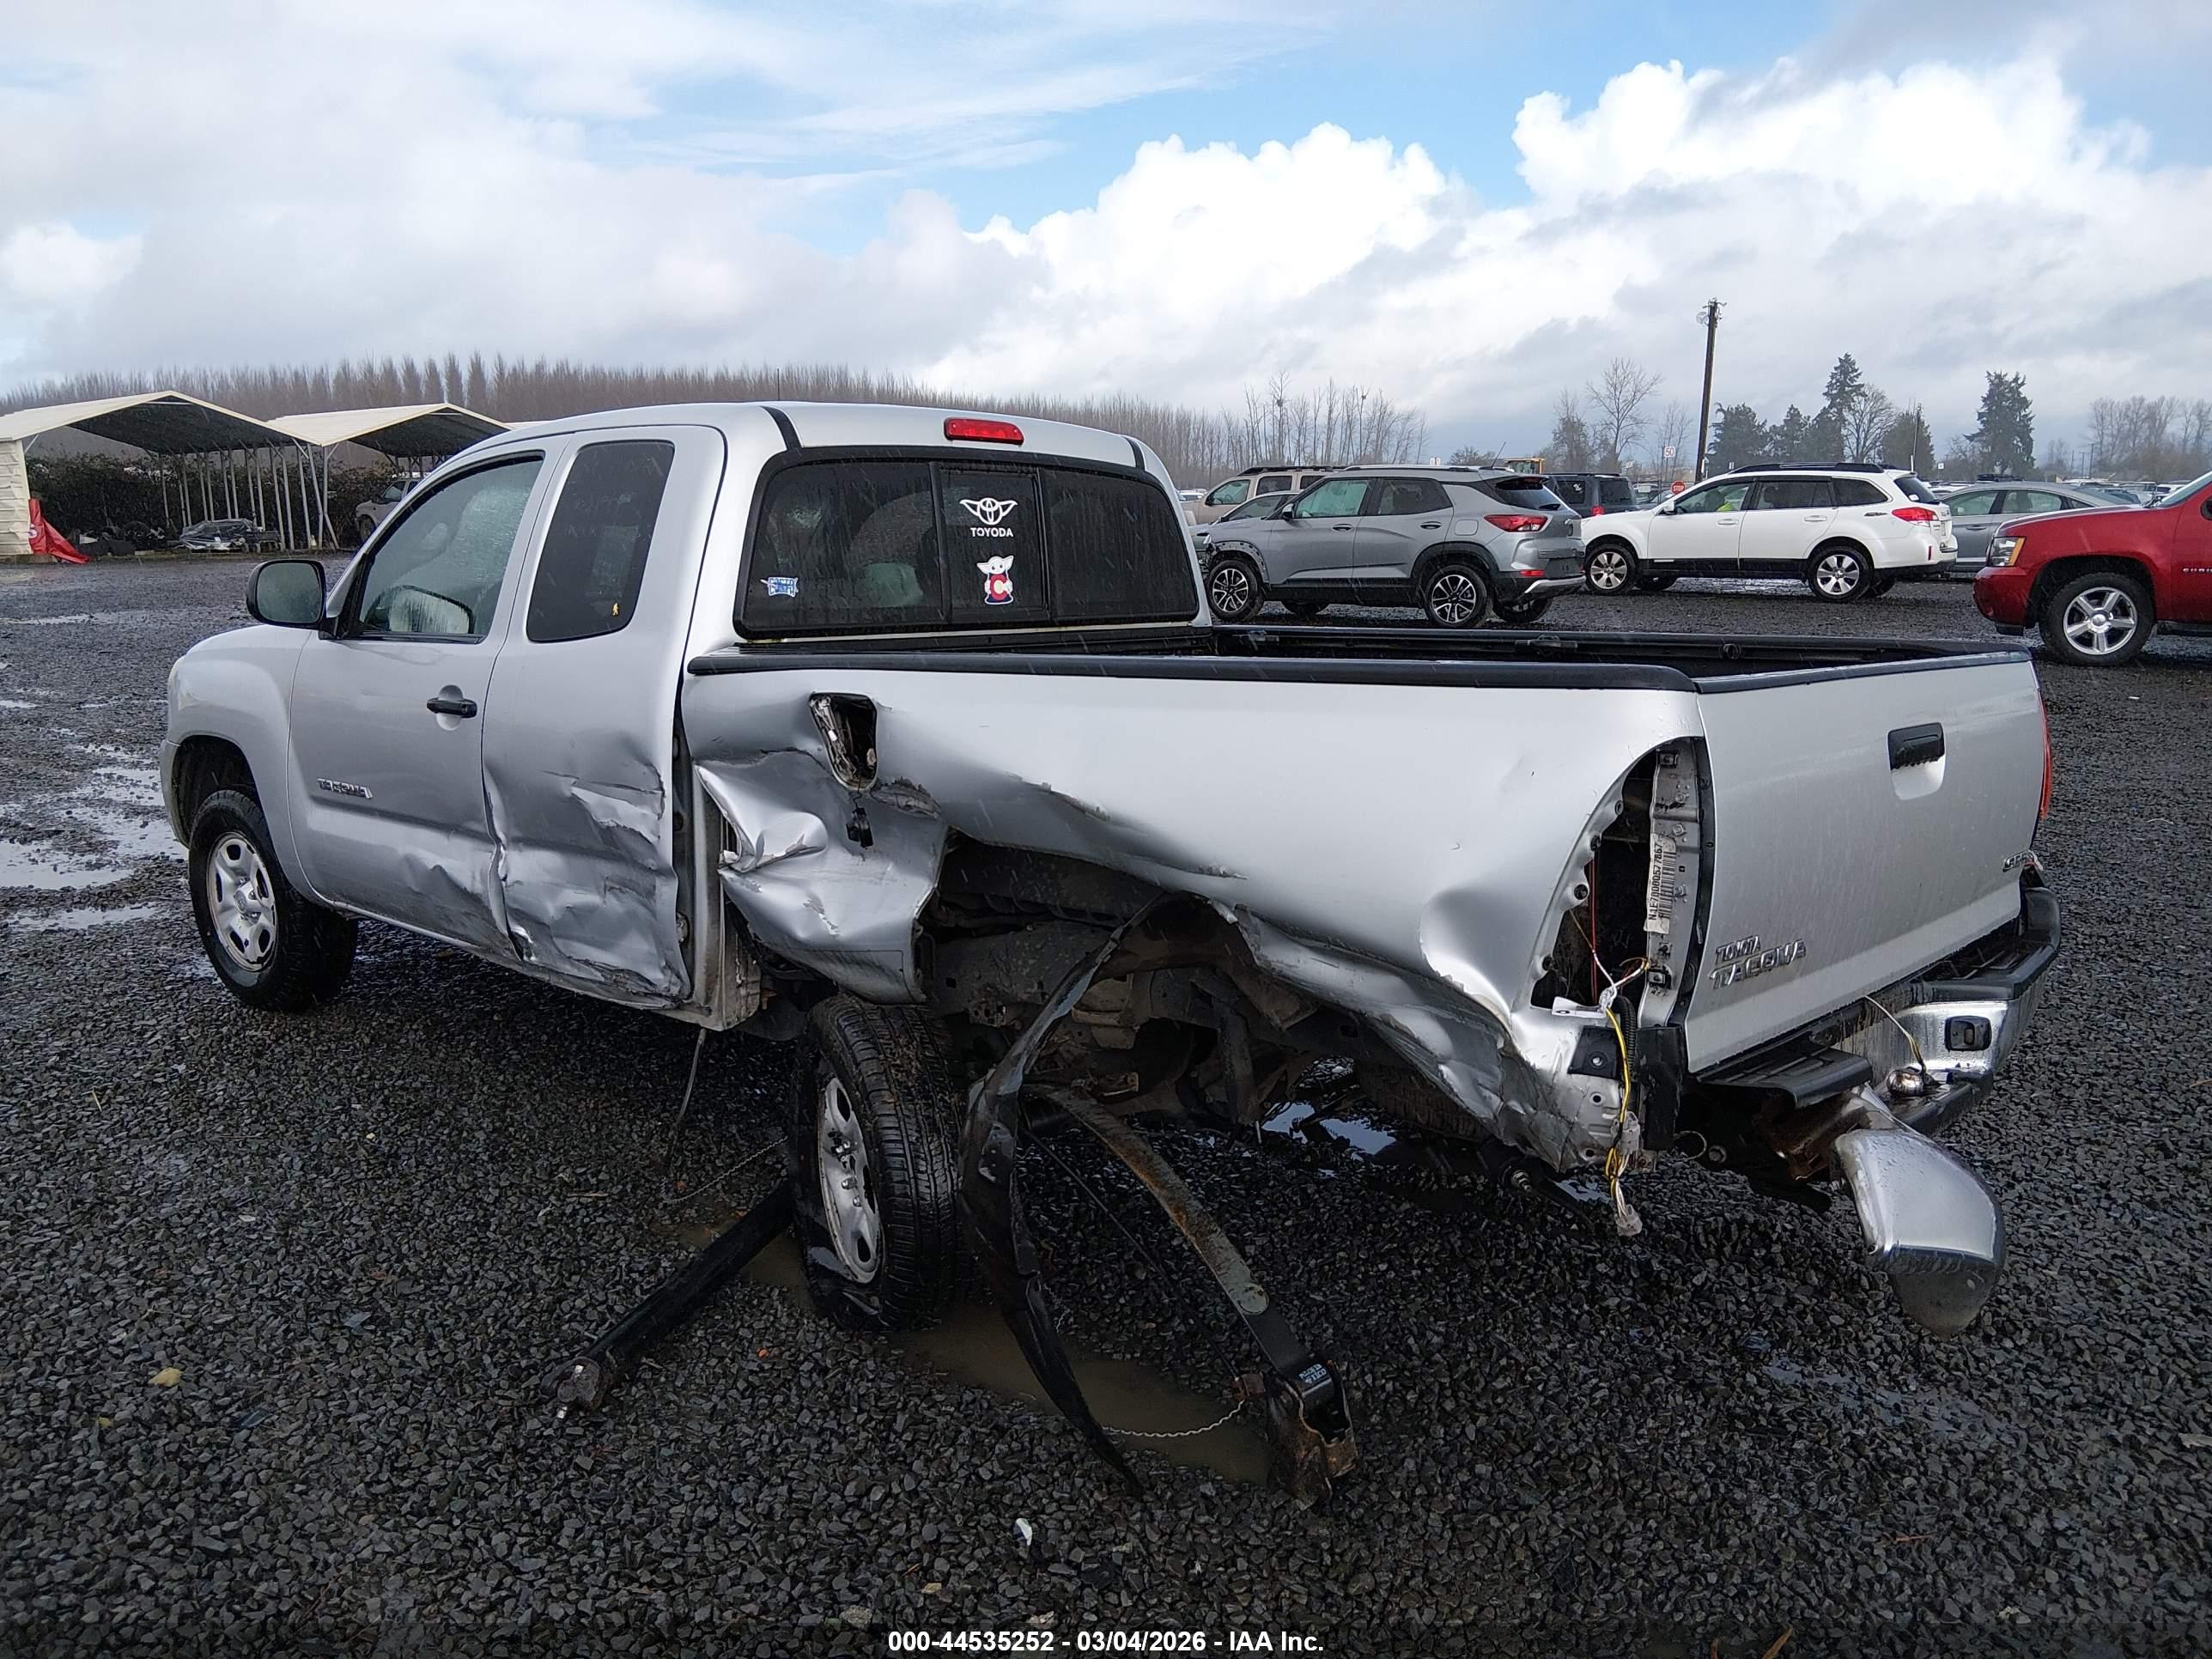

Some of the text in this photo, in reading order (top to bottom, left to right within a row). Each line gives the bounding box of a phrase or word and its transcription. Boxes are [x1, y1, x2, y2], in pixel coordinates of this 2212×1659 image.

[1665, 447, 1674, 456] 50
[970, 527, 1014, 538] TOYODA
[1716, 935, 1761, 964] TOYOTA
[1709, 939, 1807, 989] TACOMA
